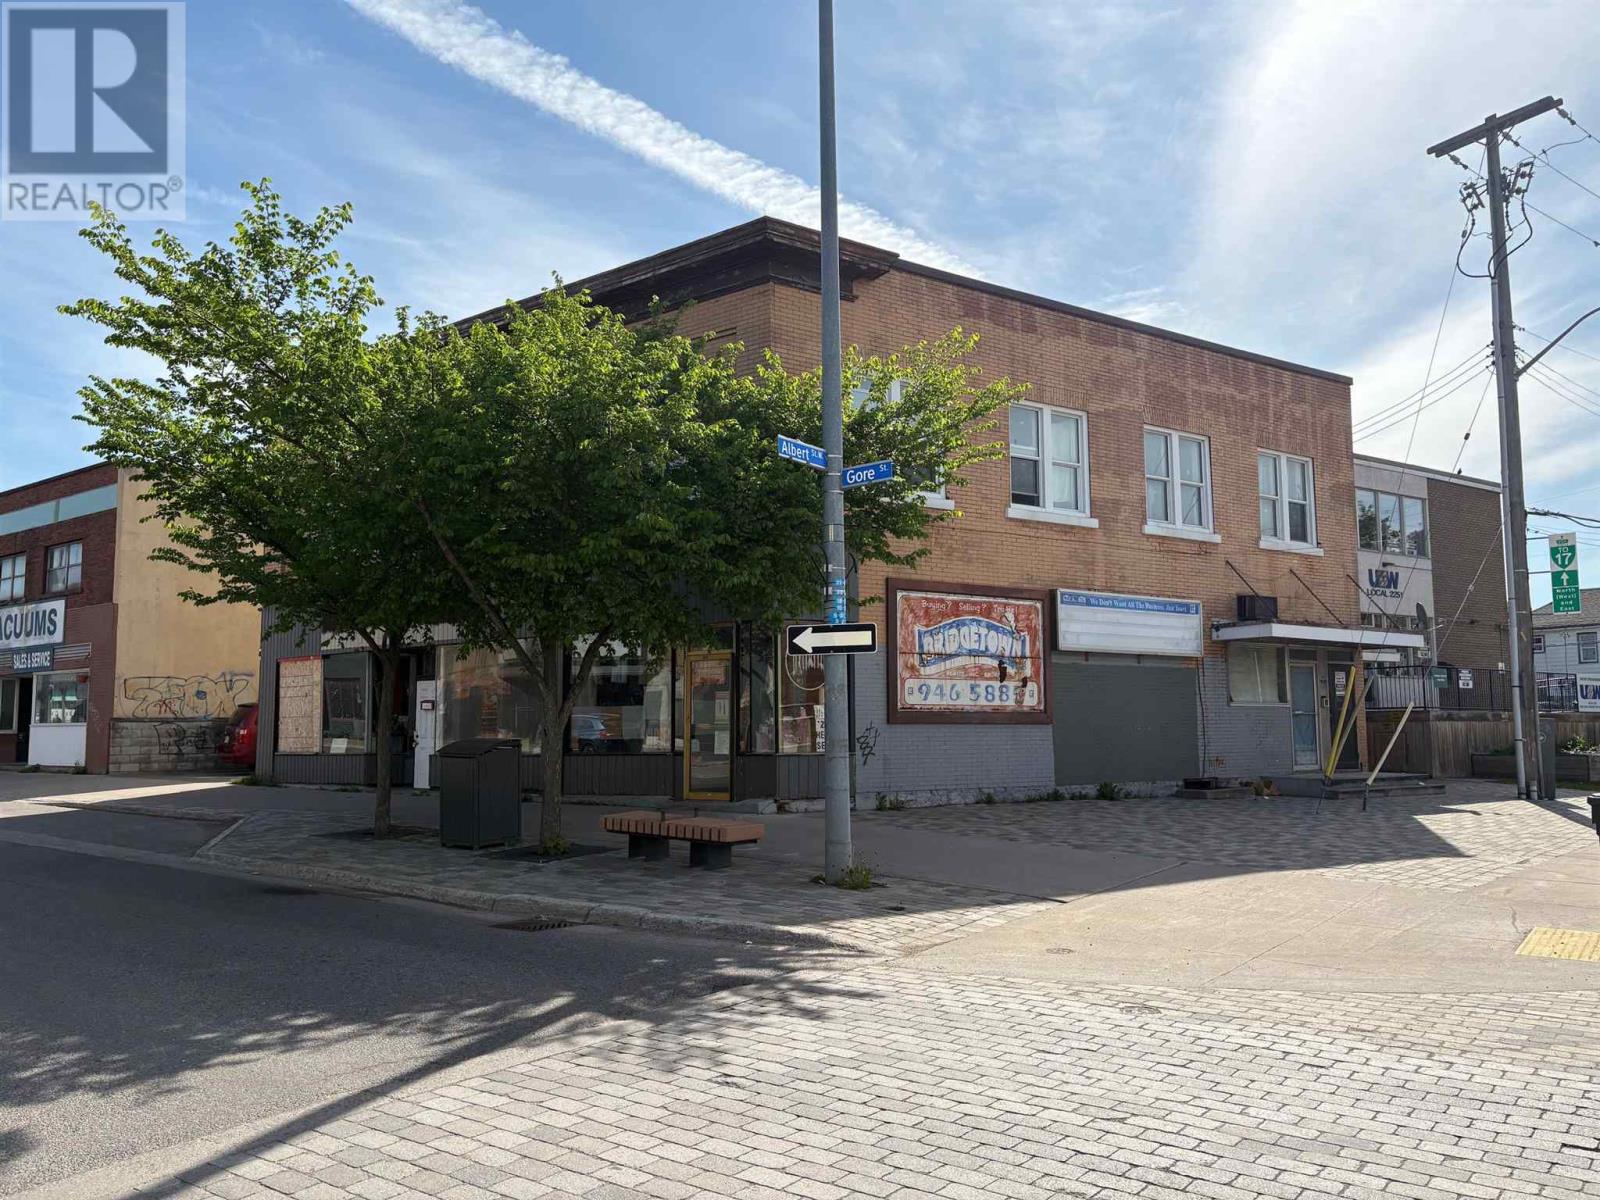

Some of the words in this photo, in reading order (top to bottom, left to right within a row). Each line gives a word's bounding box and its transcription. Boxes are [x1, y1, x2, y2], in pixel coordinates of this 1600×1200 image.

[781, 440, 809, 460] Albert
[846, 467, 875, 484] Gore
[1555, 553, 1571, 566] 17
[1366, 588, 1388, 597] LOCAL
[1389, 590, 1403, 599] 2251
[920, 600, 951, 612] Buying?
[958, 603, 987, 613] Selling?
[1089, 598, 1098, 606] We
[1099, 598, 1112, 607] Don't
[1113, 599, 1126, 608] Want
[1127, 600, 1135, 608] All
[13, 652, 27, 669] SALES
[31, 651, 51, 668] SERVICE
